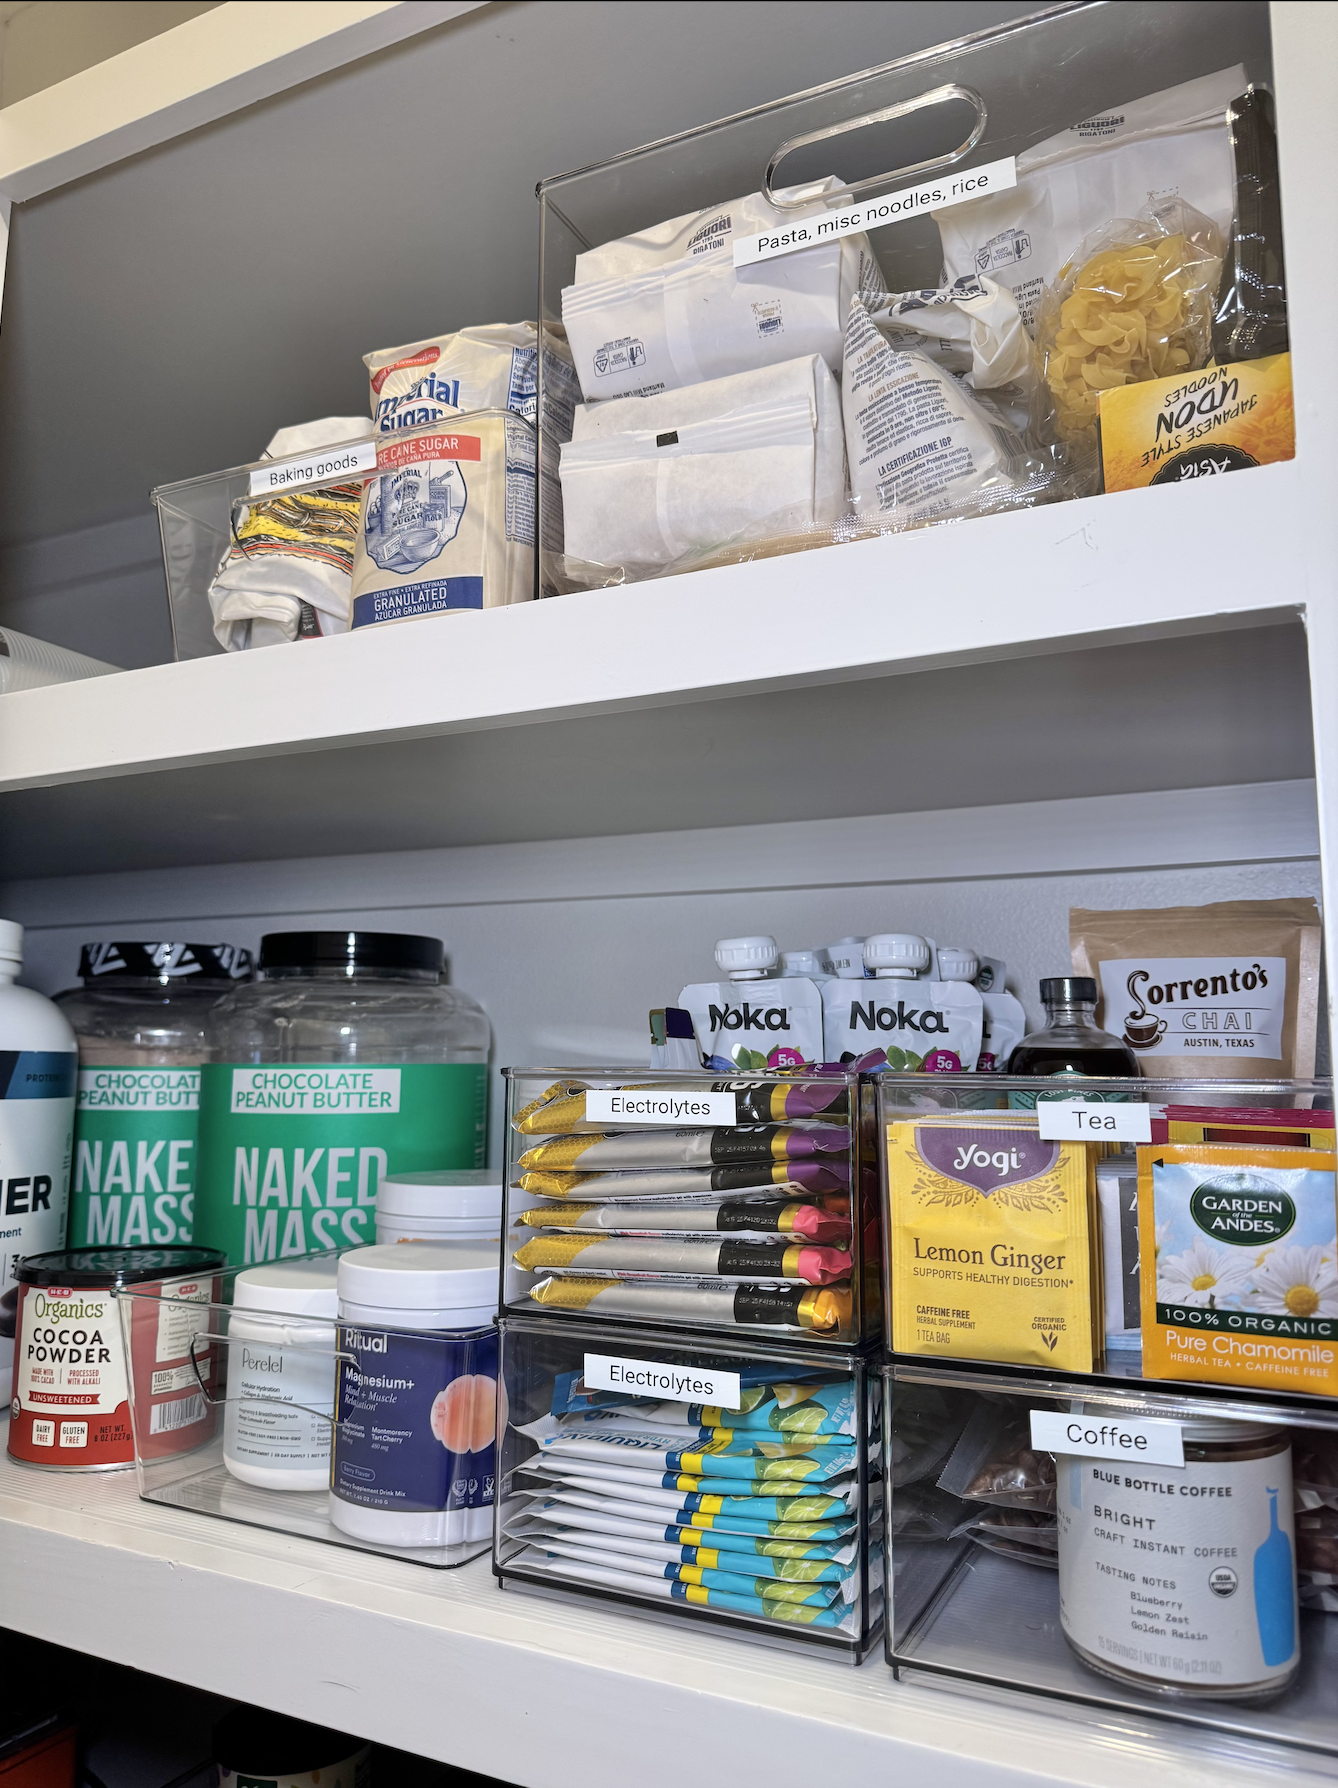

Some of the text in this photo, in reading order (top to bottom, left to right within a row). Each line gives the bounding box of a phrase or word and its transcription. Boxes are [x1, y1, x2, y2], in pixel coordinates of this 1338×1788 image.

[1079, 128, 1116, 137] RIGATONI
[757, 174, 990, 253] Pasta, misc noodles, rice
[686, 216, 732, 248] LIGUORI
[1164, 367, 1228, 408] NOODLES
[380, 407, 444, 432] Sugar
[1154, 377, 1239, 443] UDON
[1140, 394, 1258, 468] JAPANESE STYLE
[390, 438, 459, 460] CANE SUGAR
[422, 450, 440, 460] PURA
[886, 440, 939, 473] CERTIFICAZIONE
[940, 436, 952, 447] IGP
[269, 454, 358, 486] Baking goods
[374, 580, 448, 600] EXTRA FINE EXTRA REFINADA
[374, 587, 448, 612] GRANULATED
[374, 602, 448, 622] AZÚCAR GRANULADA
[1127, 963, 1268, 1020] Sorrento's
[708, 1002, 791, 1032] Noka
[850, 1000, 950, 1034] Noka
[1182, 1012, 1252, 1030] CHAI
[1184, 1038, 1254, 1048] AUSTIN, TEXAS
[936, 1056, 953, 1069] 5G
[95, 1074, 200, 1090] CHOCOLAT
[252, 1073, 373, 1090] CHOCOLATE
[78, 1090, 200, 1106] PEANUT BUTT
[235, 1092, 393, 1108] PEANUT BUTTER
[611, 1098, 711, 1119] Electrolytes
[1072, 1110, 1117, 1130] Tea
[75, 1140, 194, 1194] NAKE
[233, 1146, 388, 1208] NAKED
[1202, 1196, 1282, 1214] GARDEN
[1210, 1216, 1274, 1234] ANDES
[914, 1237, 1066, 1276] Lemon Ginger
[913, 1266, 963, 1281] SUPPORTS
[966, 1272, 1010, 1286] HEALTHY
[34, 1293, 104, 1324] Organics
[916, 1304, 970, 1320] CAFFEINE FREE
[916, 1316, 976, 1330] HERBAL SUPPLEMENT
[1031, 1322, 1067, 1331] ORGANIC
[1034, 1316, 1065, 1324] CERTIFIED
[1165, 1308, 1332, 1335] 100% ORGANIC
[33, 1327, 104, 1346] COCOA
[345, 1329, 388, 1354] Ritual
[916, 1330, 950, 1344] 1 TEA BAG
[28, 1345, 112, 1364] POWDER
[1166, 1330, 1334, 1364] Pure Chamomile
[242, 1348, 283, 1373] Perelel
[1170, 1353, 1330, 1378] HERBAL TEA CAFFEINE FREE
[32, 1367, 54, 1376] MADE WITH
[40, 1376, 55, 1384] CACAO
[67, 1377, 101, 1386] WITH ALKALI
[69, 1369, 100, 1378] PROCESSED
[154, 1371, 174, 1384] 100%
[344, 1366, 415, 1390] Magnesium+
[610, 1364, 714, 1395] Electrolytes
[241, 1381, 280, 1393] Cellular Hydration
[344, 1384, 361, 1398] Mind
[368, 1392, 398, 1404] Muscle
[32, 1392, 92, 1404] UNSWEETENED
[36, 1424, 51, 1434] DAIRY
[36, 1434, 49, 1442] FREE
[62, 1426, 86, 1436] GLUTEN
[94, 1434, 99, 1442] 8
[100, 1434, 109, 1442] OZ
[99, 1424, 127, 1434] NET WT.
[372, 1426, 413, 1438] Montmorency
[372, 1434, 404, 1444] Tart Cherry
[1066, 1424, 1148, 1450] Coffee
[65, 1435, 80, 1444] FREE
[354, 1468, 371, 1478] Flavor
[1093, 1468, 1233, 1498] BLUE BOTTLE COFFEE
[352, 1482, 379, 1496] Supplement
[379, 1487, 394, 1496] Drink
[394, 1490, 406, 1498] Mix
[1094, 1504, 1156, 1532] BRIGHT
[1094, 1528, 1238, 1558] CRAFT INSTANT COFFEE
[1095, 1561, 1176, 1590] TASTING NOTES
[1215, 1574, 1232, 1582] USDA
[1130, 1591, 1183, 1611] Blueberry
[1130, 1606, 1190, 1625] Lemon Zest
[1131, 1620, 1208, 1641] Golden Raisin
[1106, 1637, 1139, 1662] SERVINGS
[1143, 1650, 1158, 1666] NET
[1159, 1652, 1172, 1668] WT
